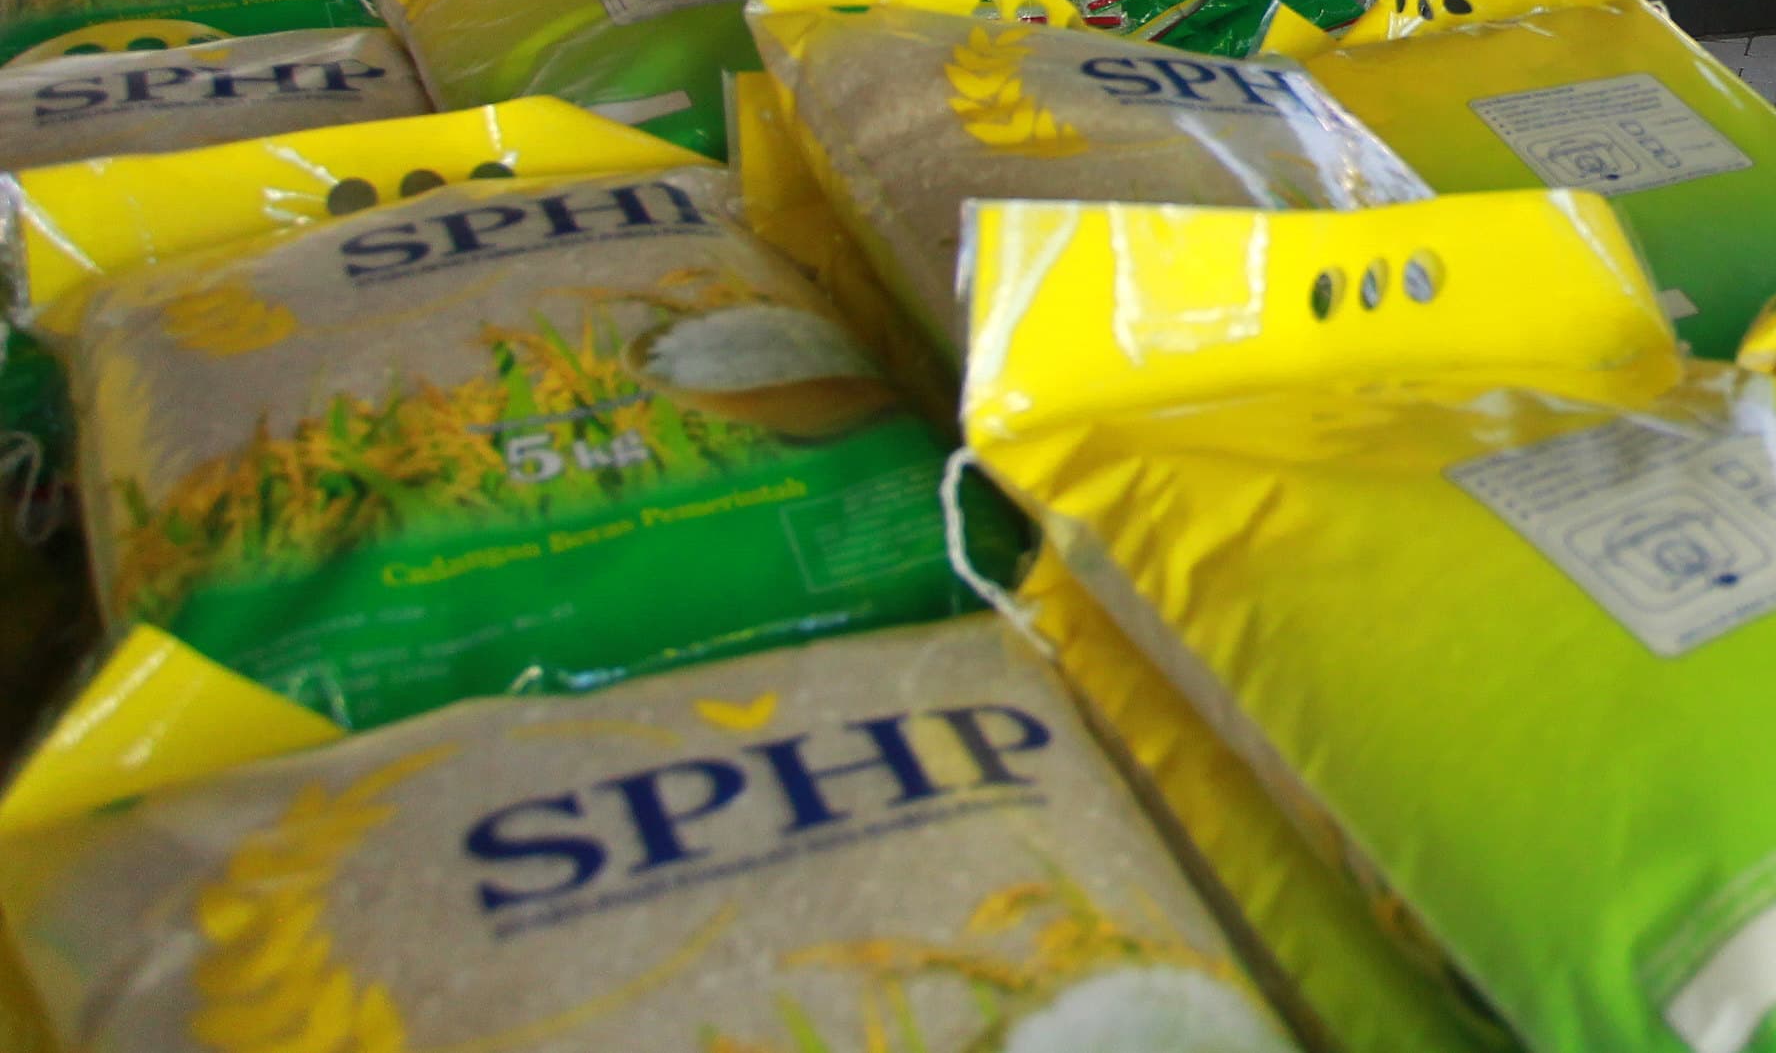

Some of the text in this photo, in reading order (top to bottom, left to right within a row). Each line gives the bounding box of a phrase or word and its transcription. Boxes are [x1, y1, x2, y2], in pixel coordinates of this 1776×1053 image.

[35, 57, 387, 119] SPHP
[1080, 56, 1335, 129] SPH
[507, 433, 563, 484] 5
[463, 703, 1054, 911] SPHP
